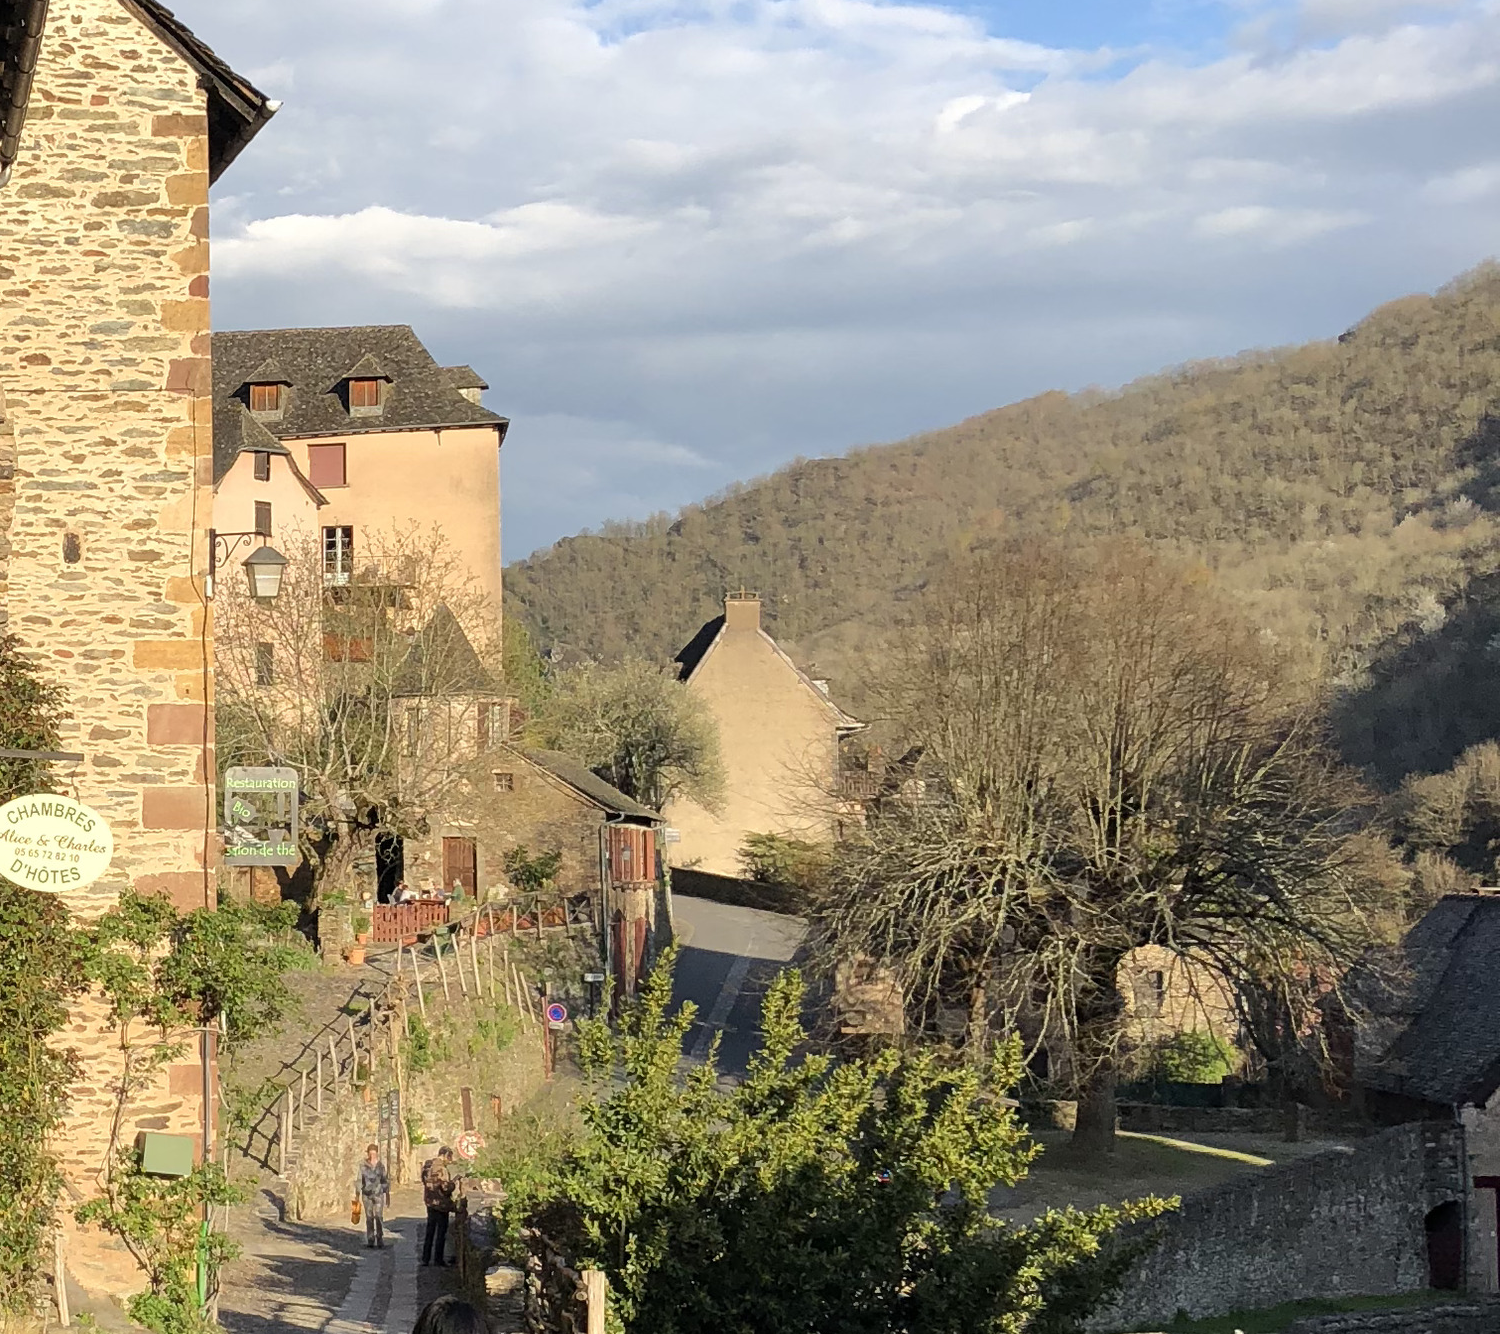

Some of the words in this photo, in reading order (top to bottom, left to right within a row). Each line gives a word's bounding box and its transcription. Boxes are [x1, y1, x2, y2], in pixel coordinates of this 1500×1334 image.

[226, 777, 296, 789] Restauration
[7, 802, 96, 832] CHAMBRES
[36, 834, 50, 846] &
[54, 835, 106, 854] Charles
[259, 841, 274, 857] de
[277, 842, 296, 856] thé
[14, 847, 26, 857] 05
[28, 848, 39, 858] 65
[42, 850, 53, 860] 72
[69, 854, 80, 863] 10
[10, 859, 81, 884] D'HÔTES
